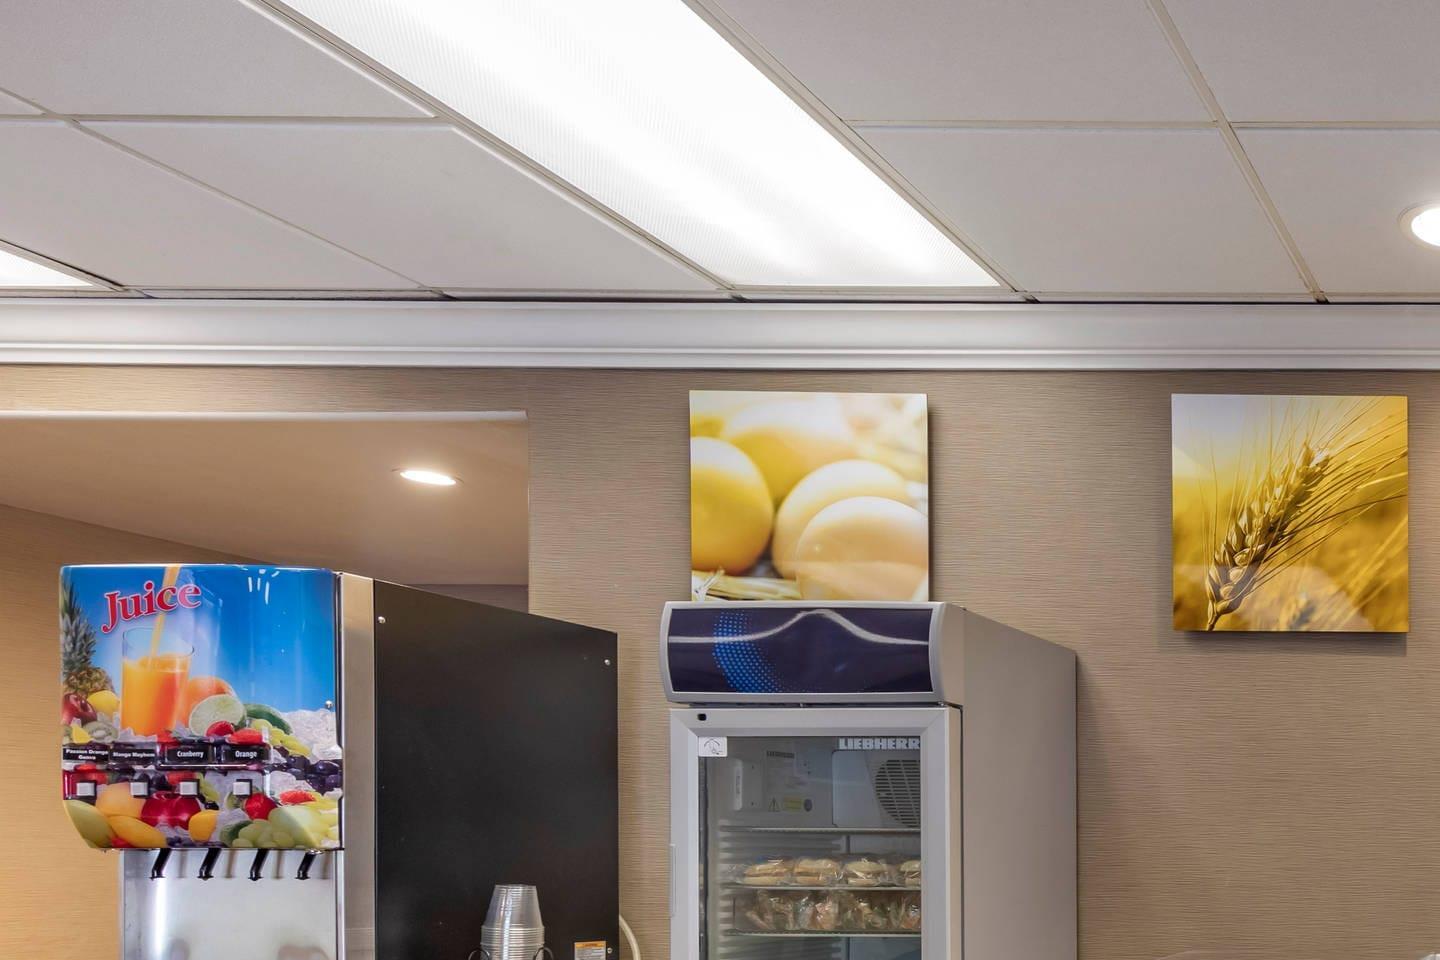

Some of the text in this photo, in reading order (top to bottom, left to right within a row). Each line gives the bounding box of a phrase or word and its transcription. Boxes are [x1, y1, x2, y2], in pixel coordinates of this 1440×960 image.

[101, 580, 202, 633] Juice
[839, 737, 920, 750] LIEBHERR
[176, 750, 204, 758] Cranberry
[235, 750, 257, 759] Orange
